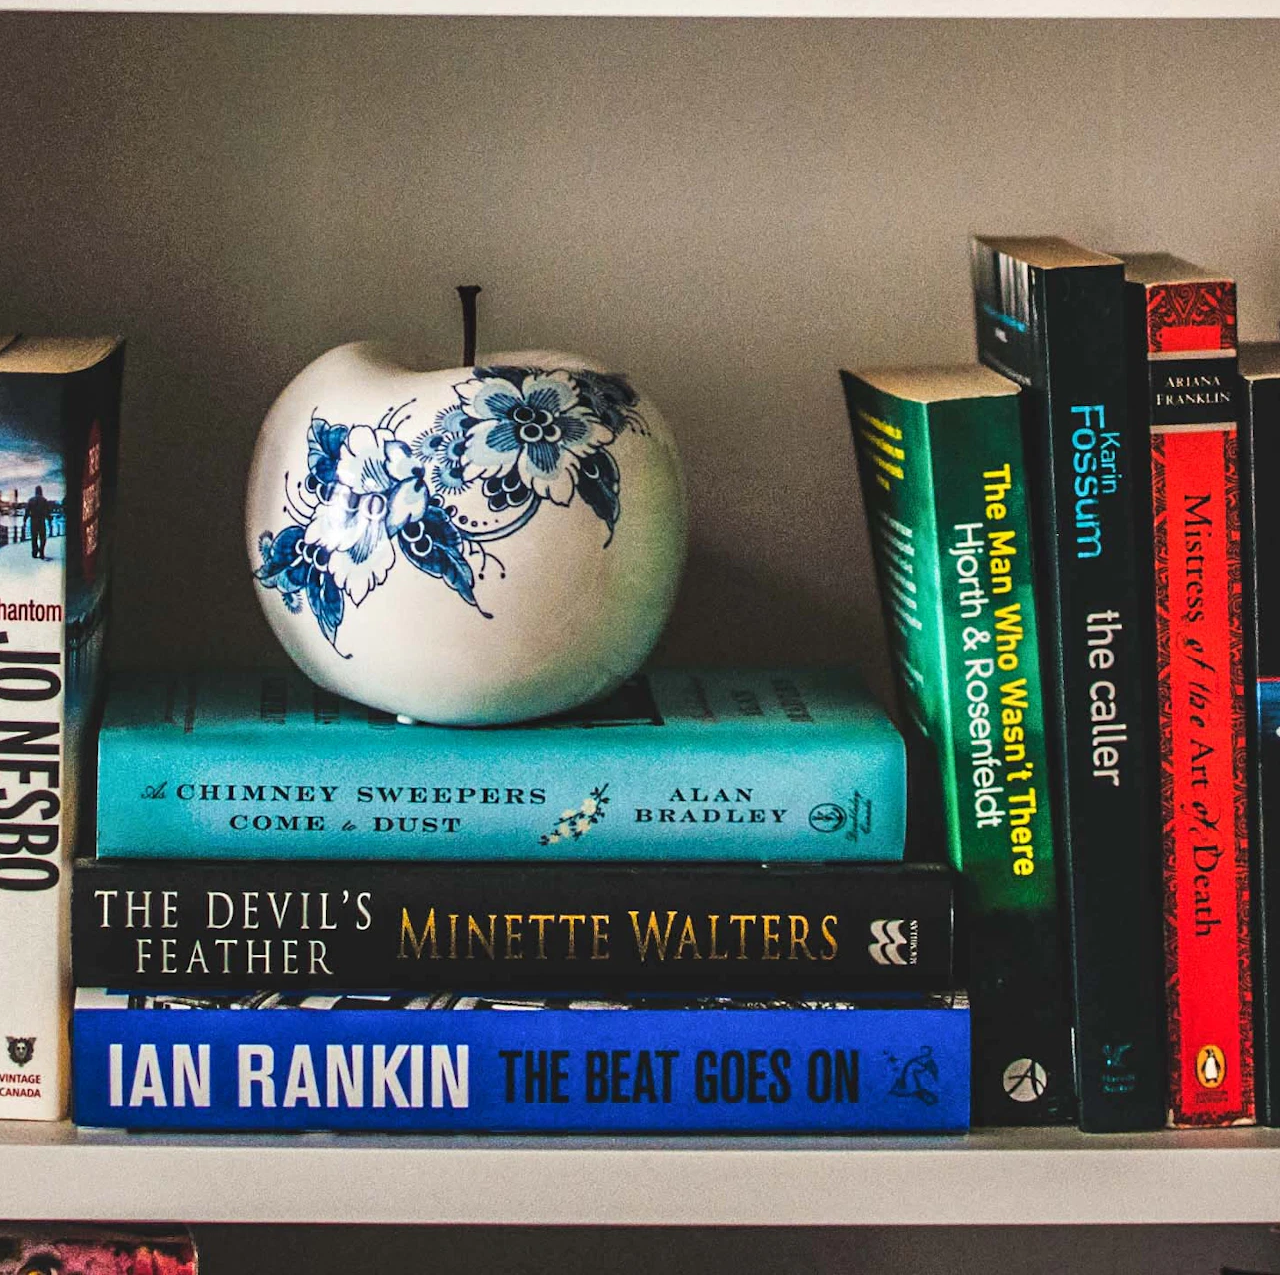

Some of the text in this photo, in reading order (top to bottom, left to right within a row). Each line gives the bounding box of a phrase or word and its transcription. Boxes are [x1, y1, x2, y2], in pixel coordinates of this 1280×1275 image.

[175, 783, 340, 804] CHIMNEY
[357, 787, 548, 805] SWEEPERS
[670, 787, 755, 804] ALAN
[228, 815, 326, 834] COME
[371, 816, 462, 834] DUST
[633, 808, 789, 825] BRADLEY
